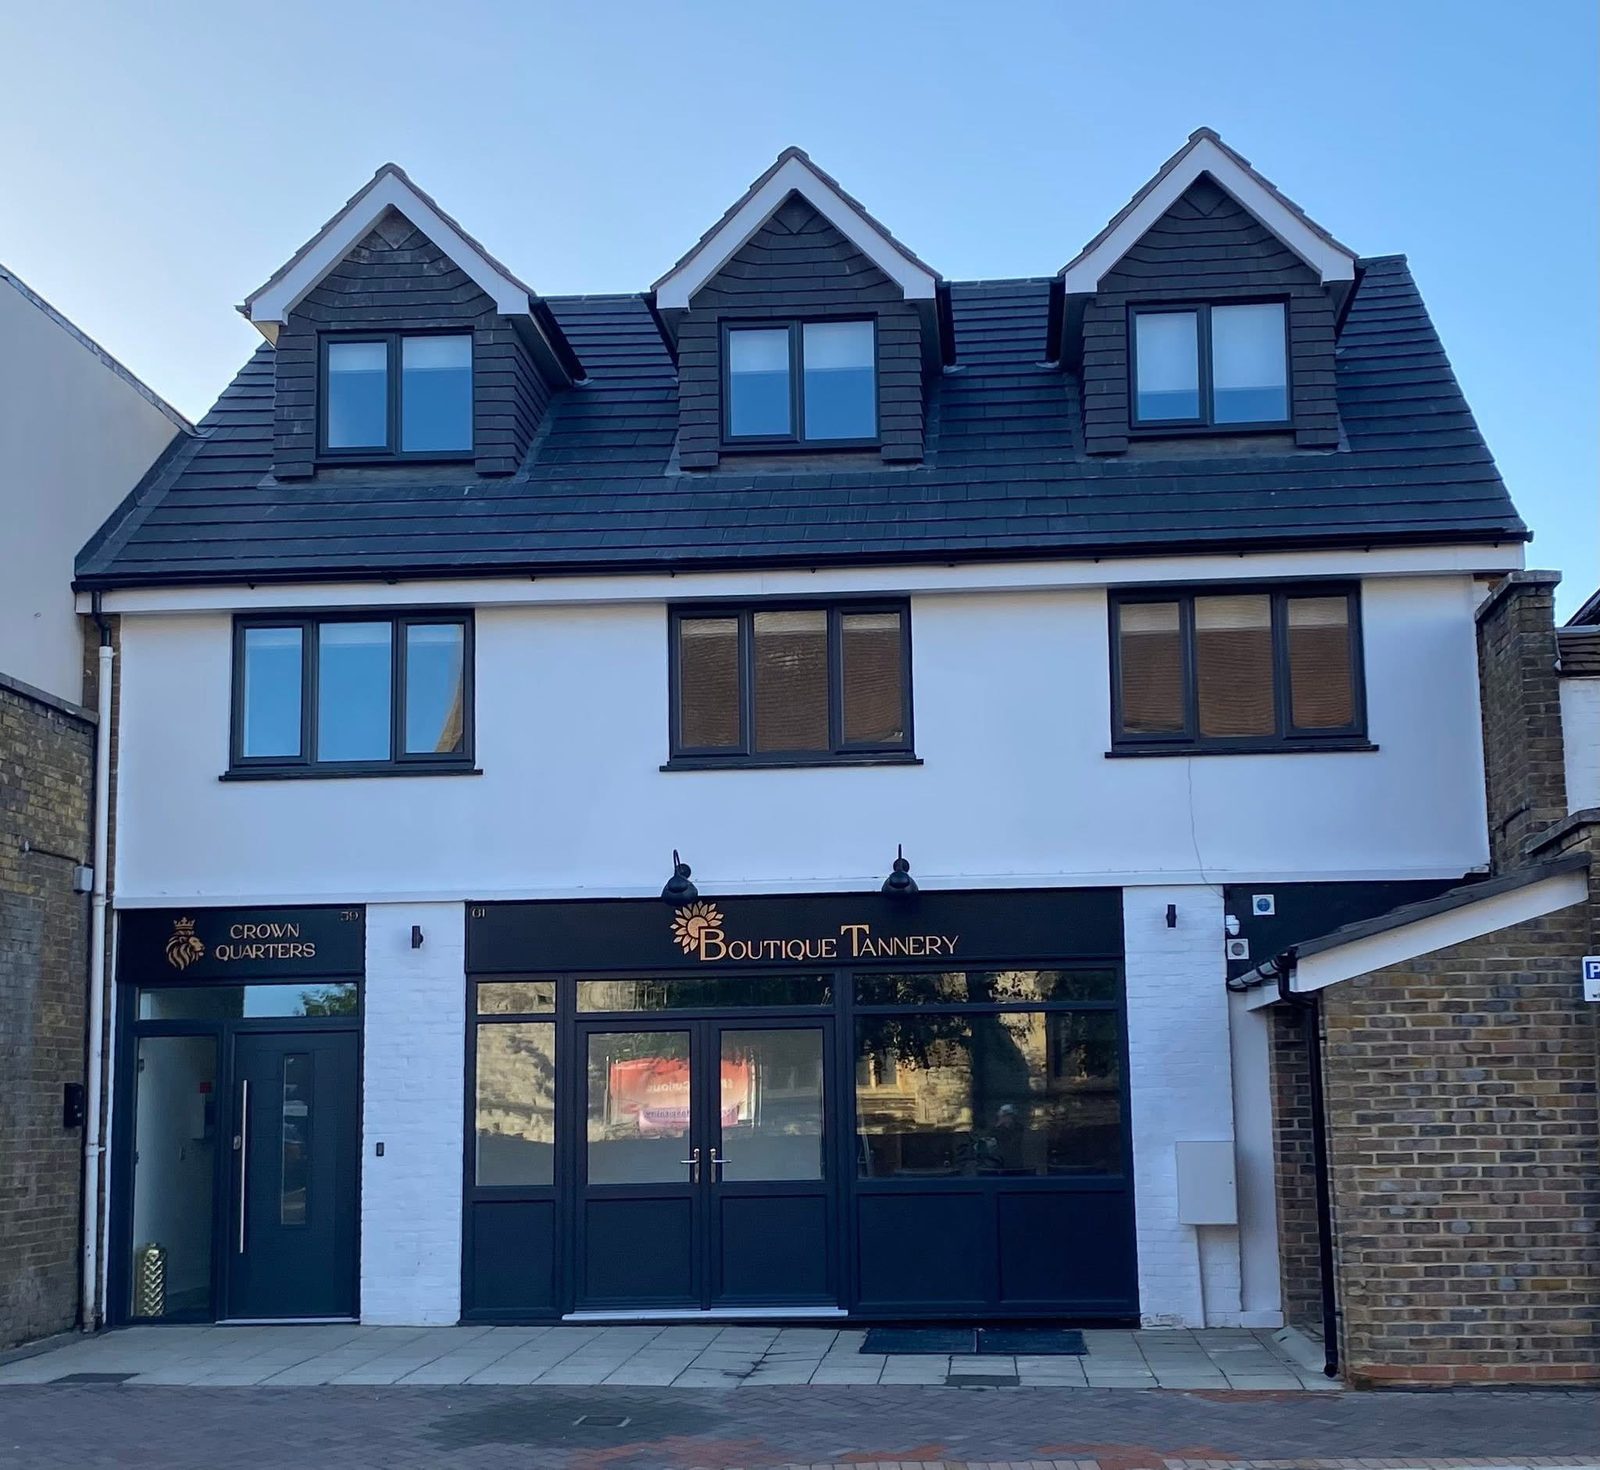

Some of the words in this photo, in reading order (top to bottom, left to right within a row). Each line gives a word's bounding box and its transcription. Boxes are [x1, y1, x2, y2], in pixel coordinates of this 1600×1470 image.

[230, 923, 300, 940] CROWN
[215, 942, 316, 962] QUARTERS
[699, 927, 837, 961] BOUTIQUE
[840, 923, 959, 957] TANNERY
